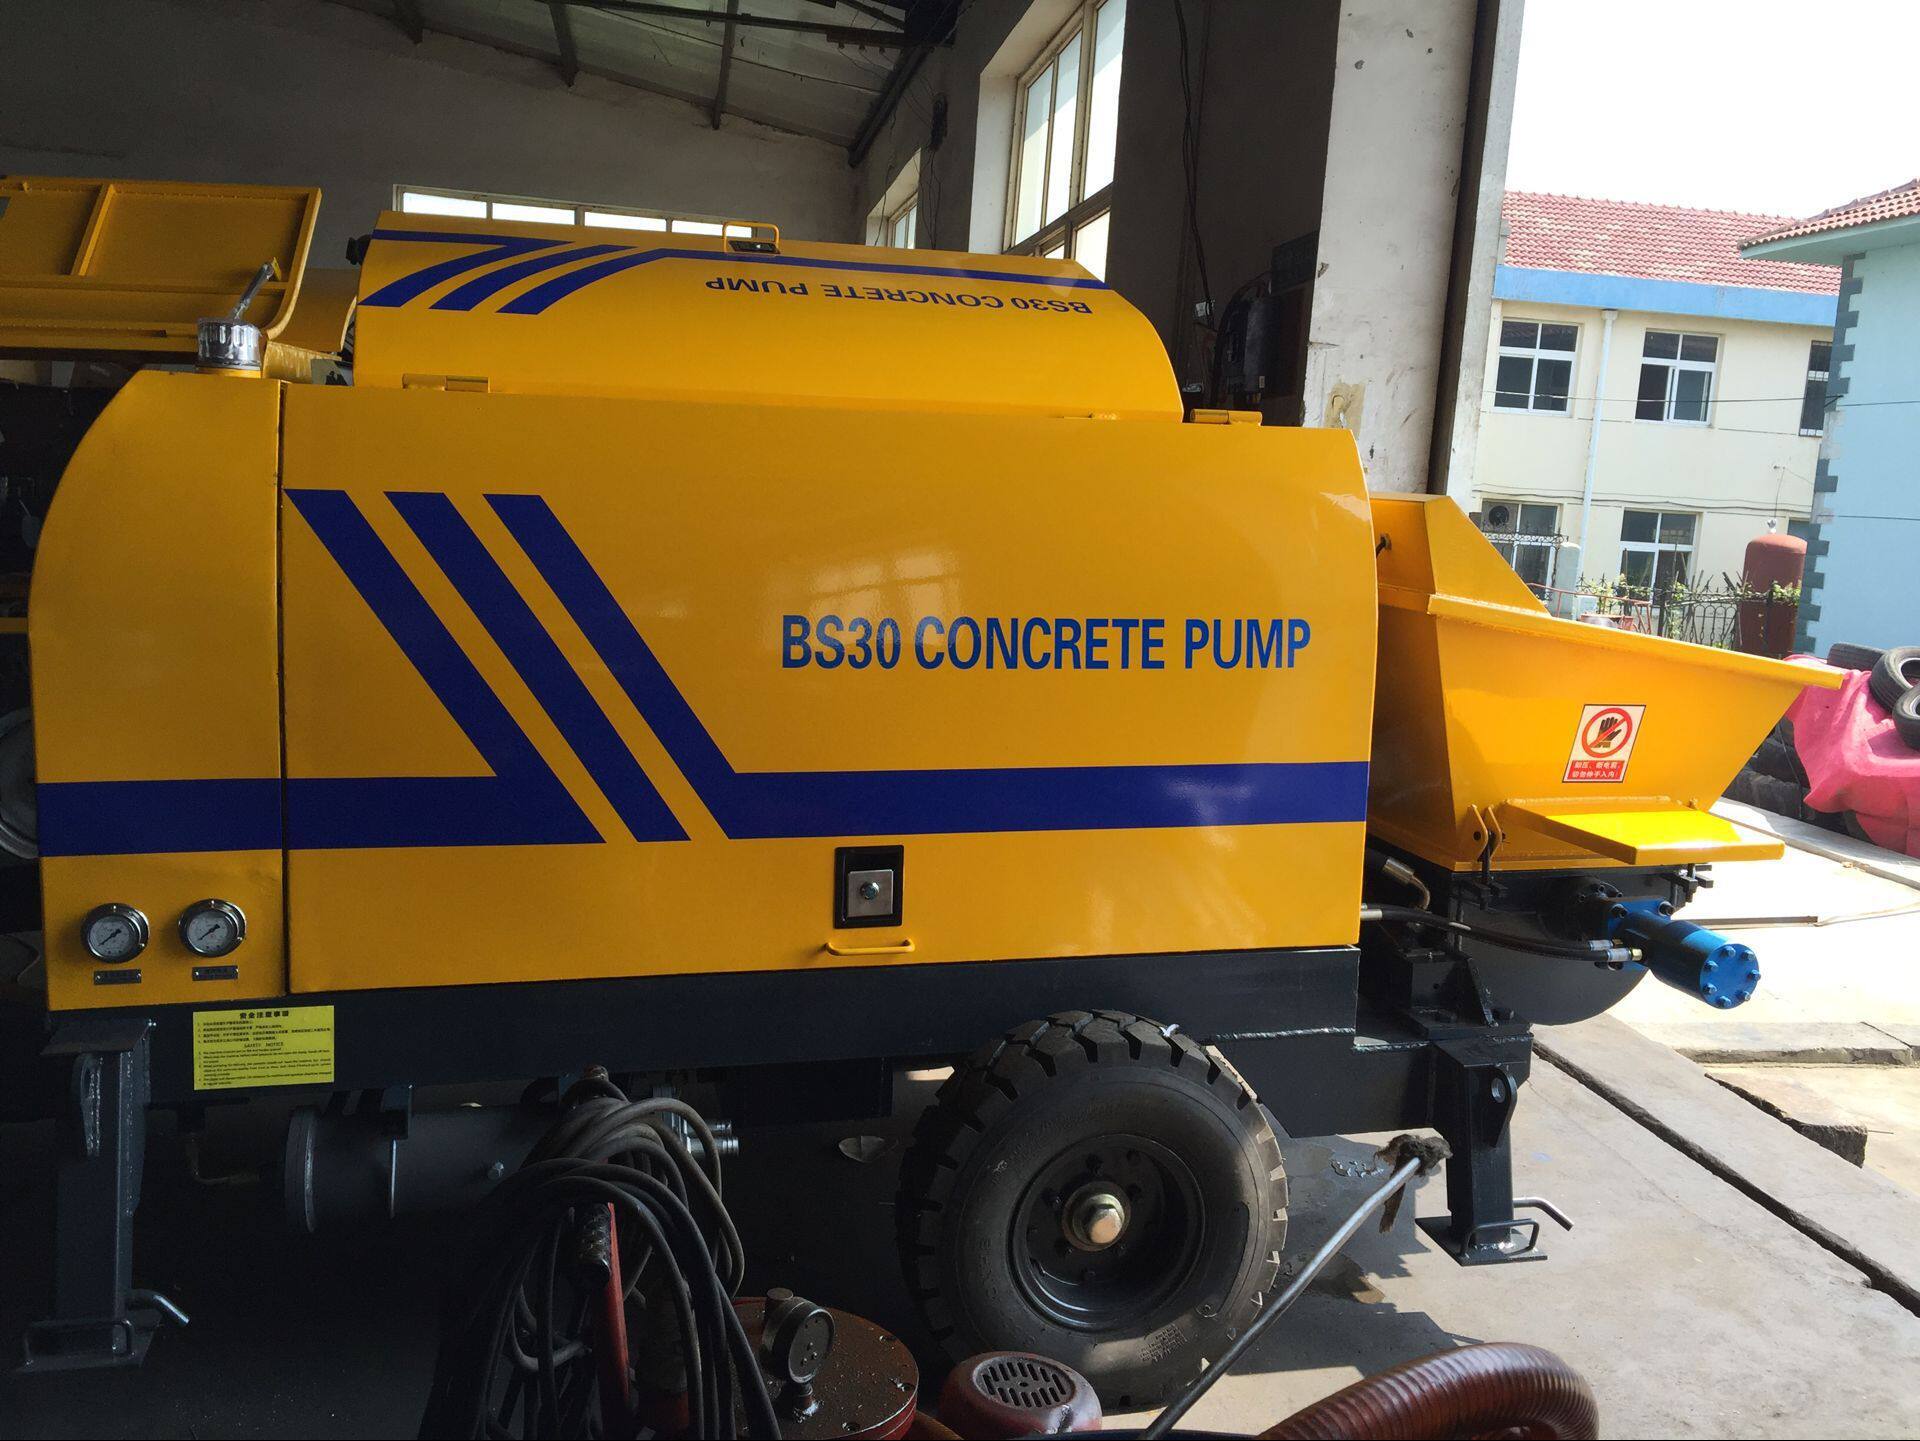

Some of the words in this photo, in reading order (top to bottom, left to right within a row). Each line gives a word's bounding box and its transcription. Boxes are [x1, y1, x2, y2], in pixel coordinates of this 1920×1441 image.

[706, 277, 809, 296] PUMP
[824, 284, 1004, 309] CONCRETE
[1011, 298, 1092, 315] BS30
[782, 615, 900, 669] BS30
[914, 616, 1165, 670] CONCRETE
[1184, 618, 1311, 670] PUMP
